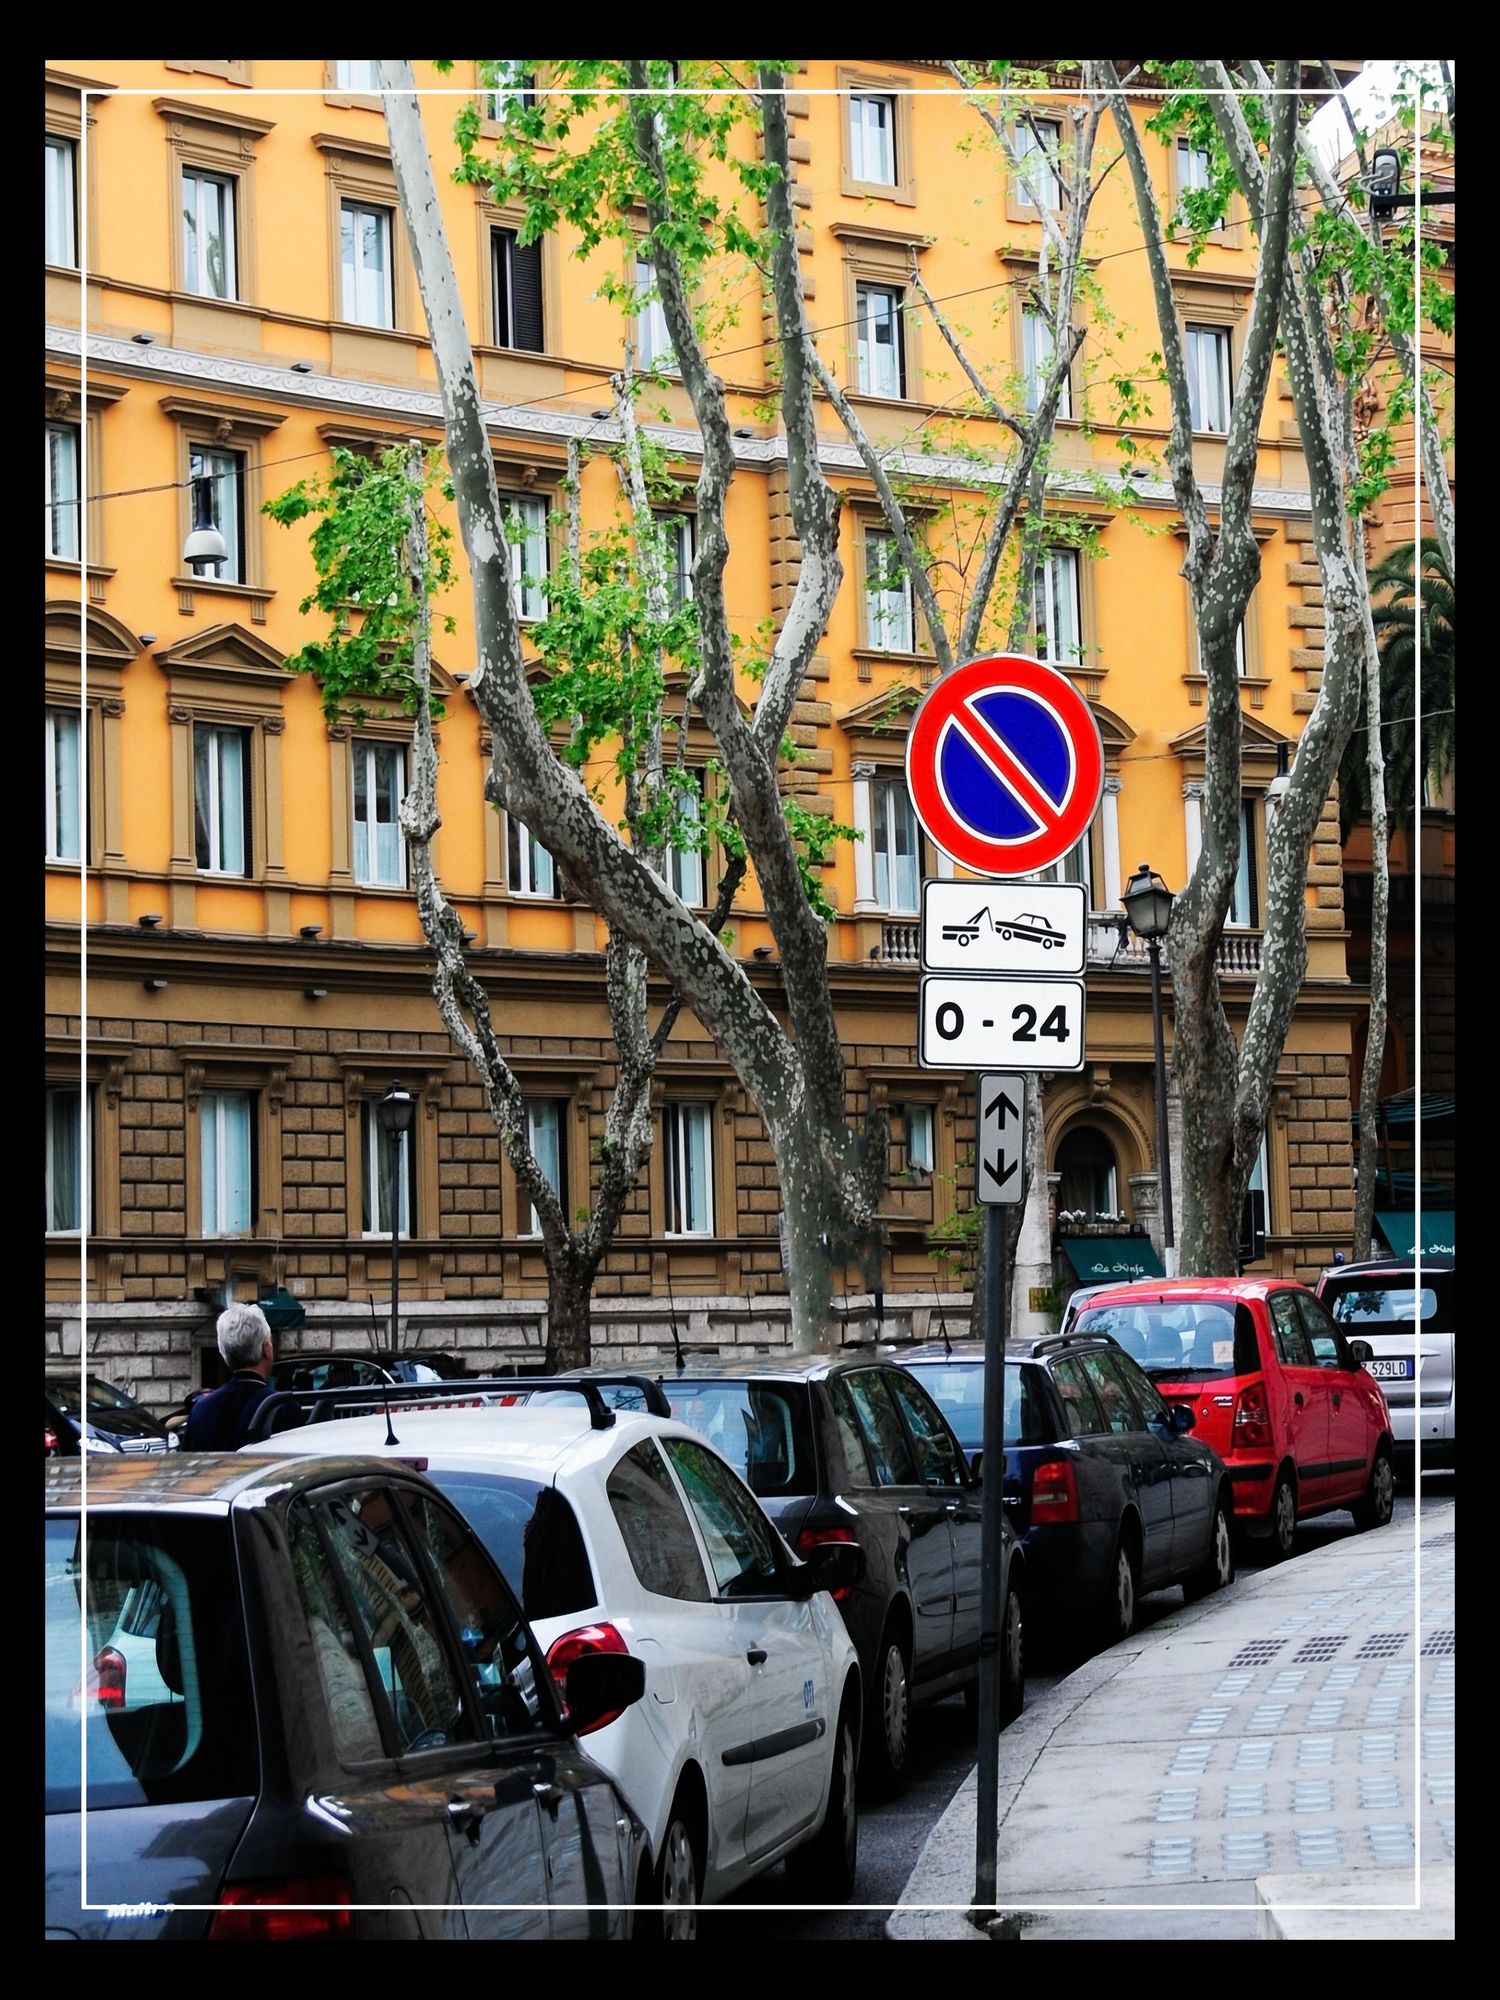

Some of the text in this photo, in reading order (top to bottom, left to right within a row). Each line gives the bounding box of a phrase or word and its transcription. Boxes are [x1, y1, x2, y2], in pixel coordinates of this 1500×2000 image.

[935, 1001, 1070, 1043] 0 - 24
[1090, 1262, 1110, 1273] La
[1371, 1361, 1406, 1376] 529LD
